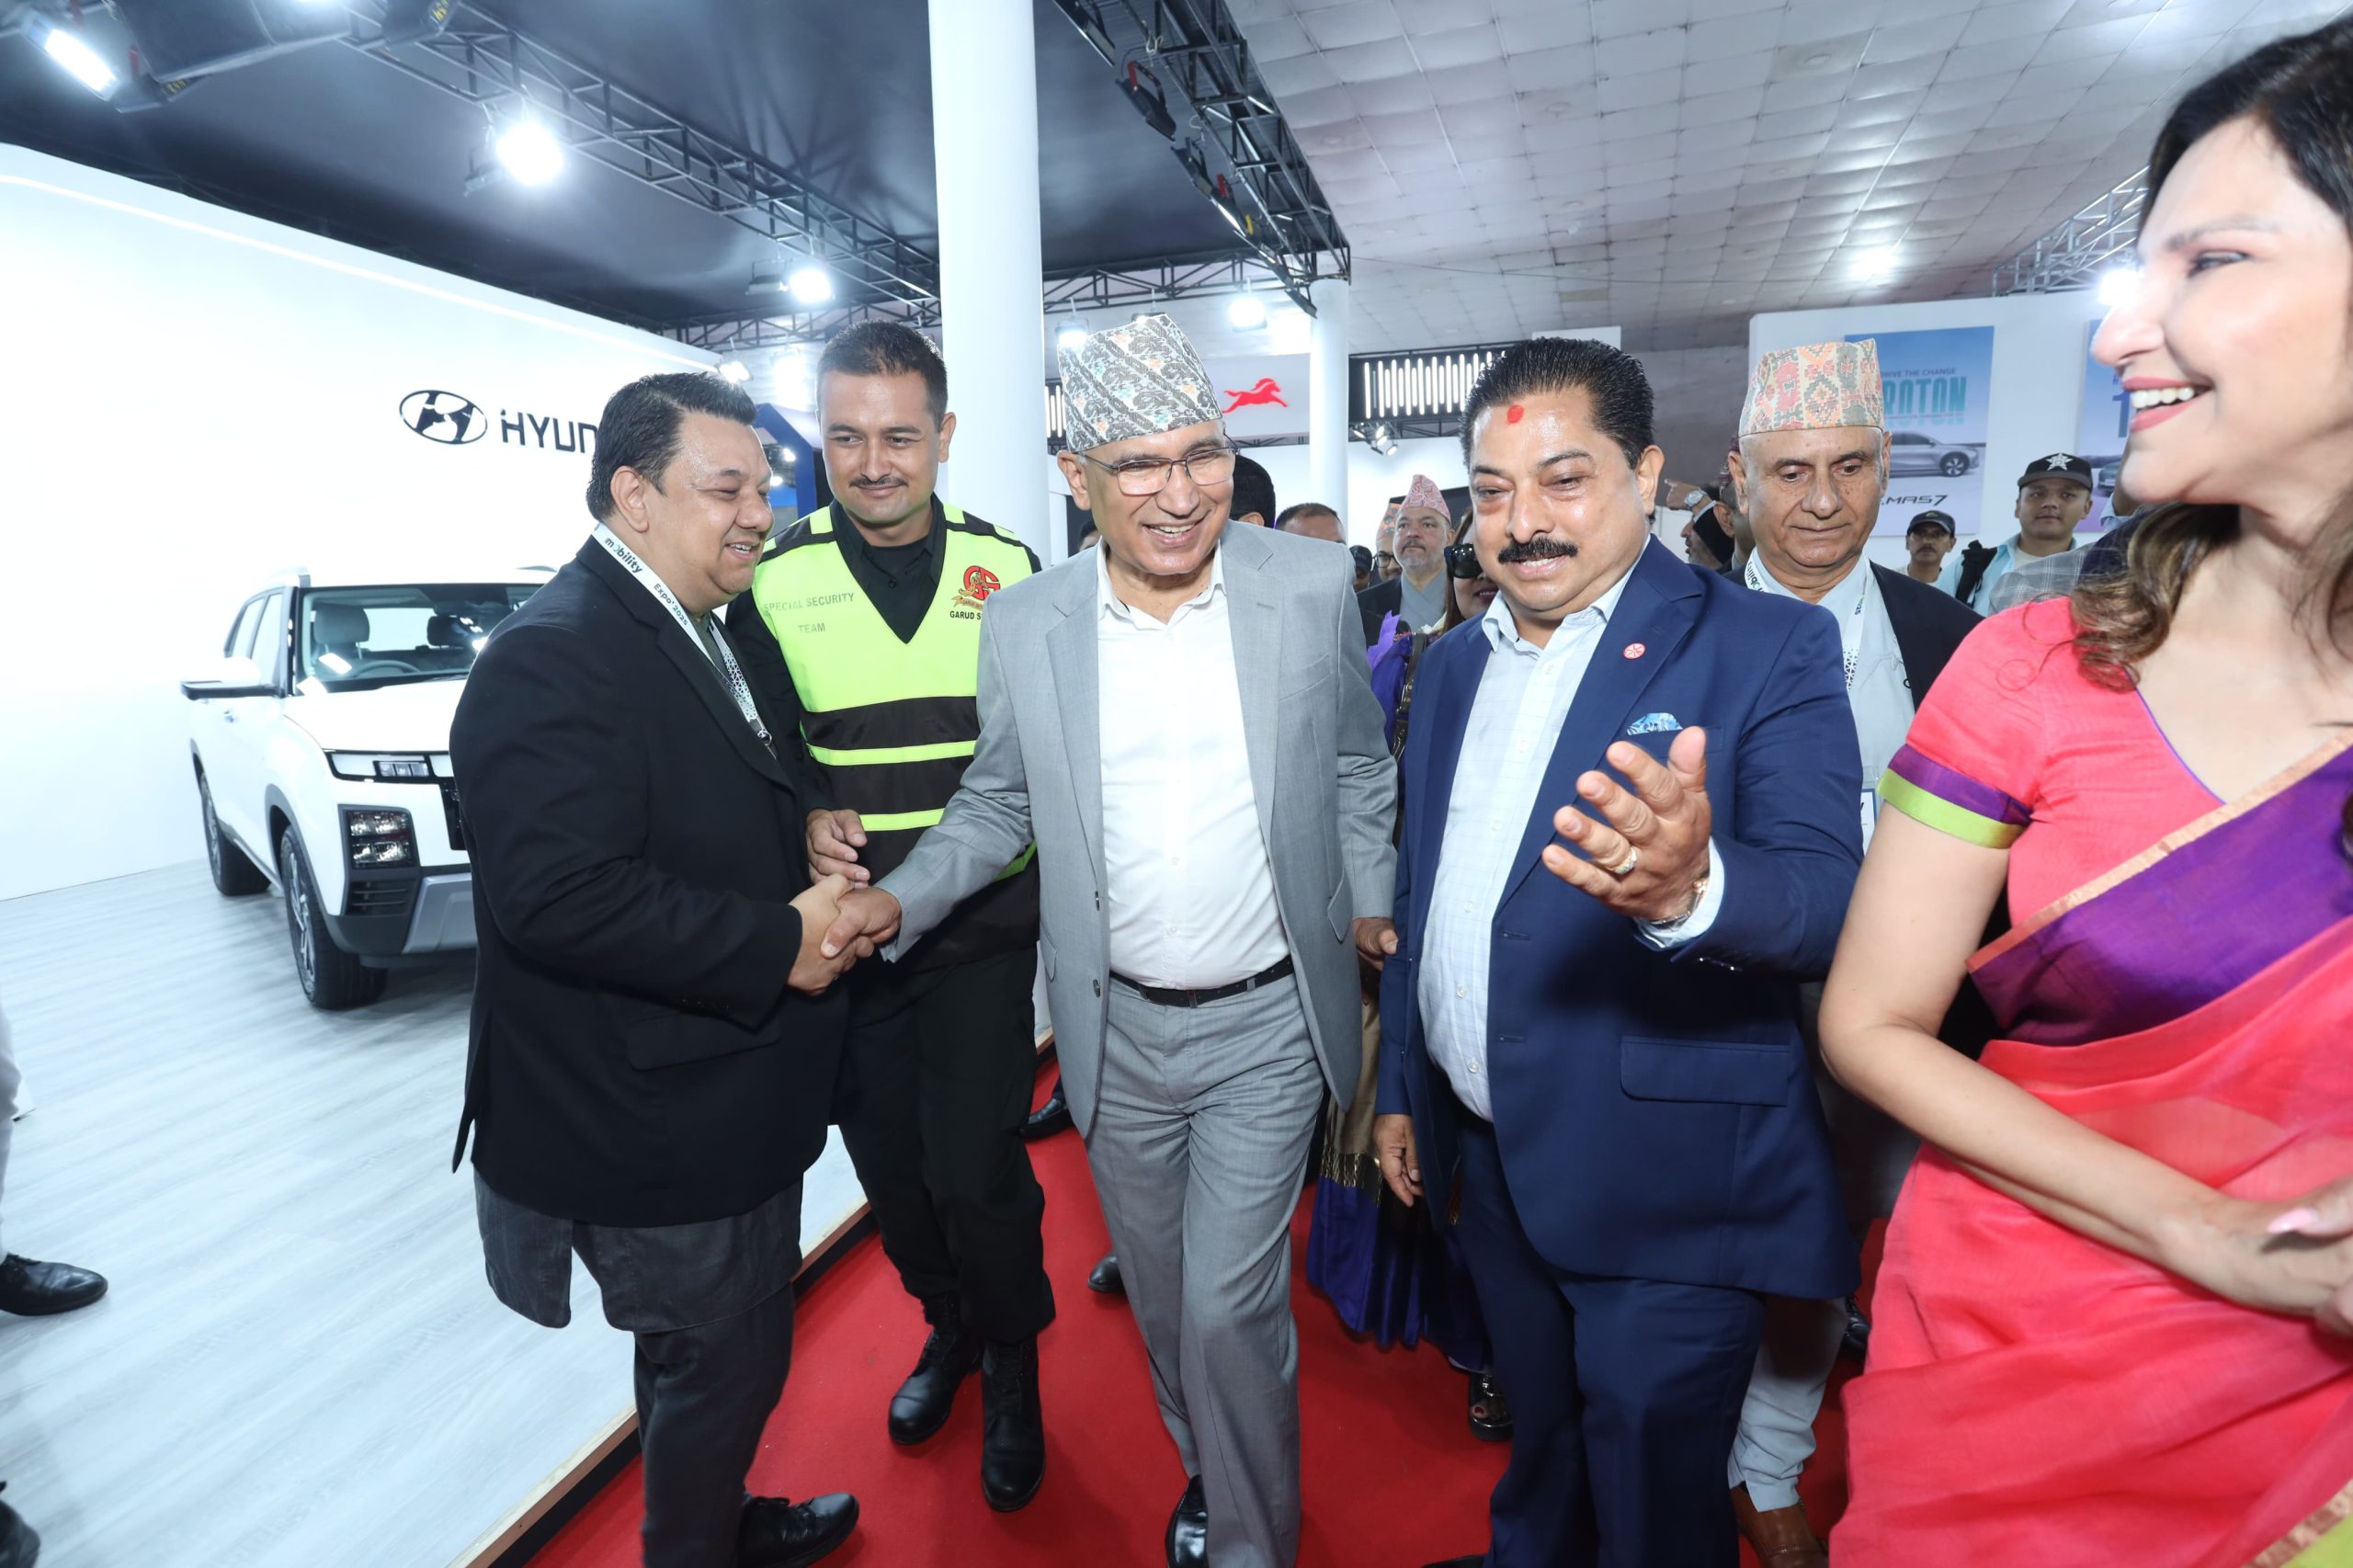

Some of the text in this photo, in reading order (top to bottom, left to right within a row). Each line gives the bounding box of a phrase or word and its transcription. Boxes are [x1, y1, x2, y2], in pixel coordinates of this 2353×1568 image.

[1904, 369, 1919, 377] THE
[1922, 367, 1957, 376] CHANGE
[764, 592, 855, 612] SPECIAL SECURITY
[949, 610, 974, 619] GARUD
[798, 622, 825, 633] TEAM
